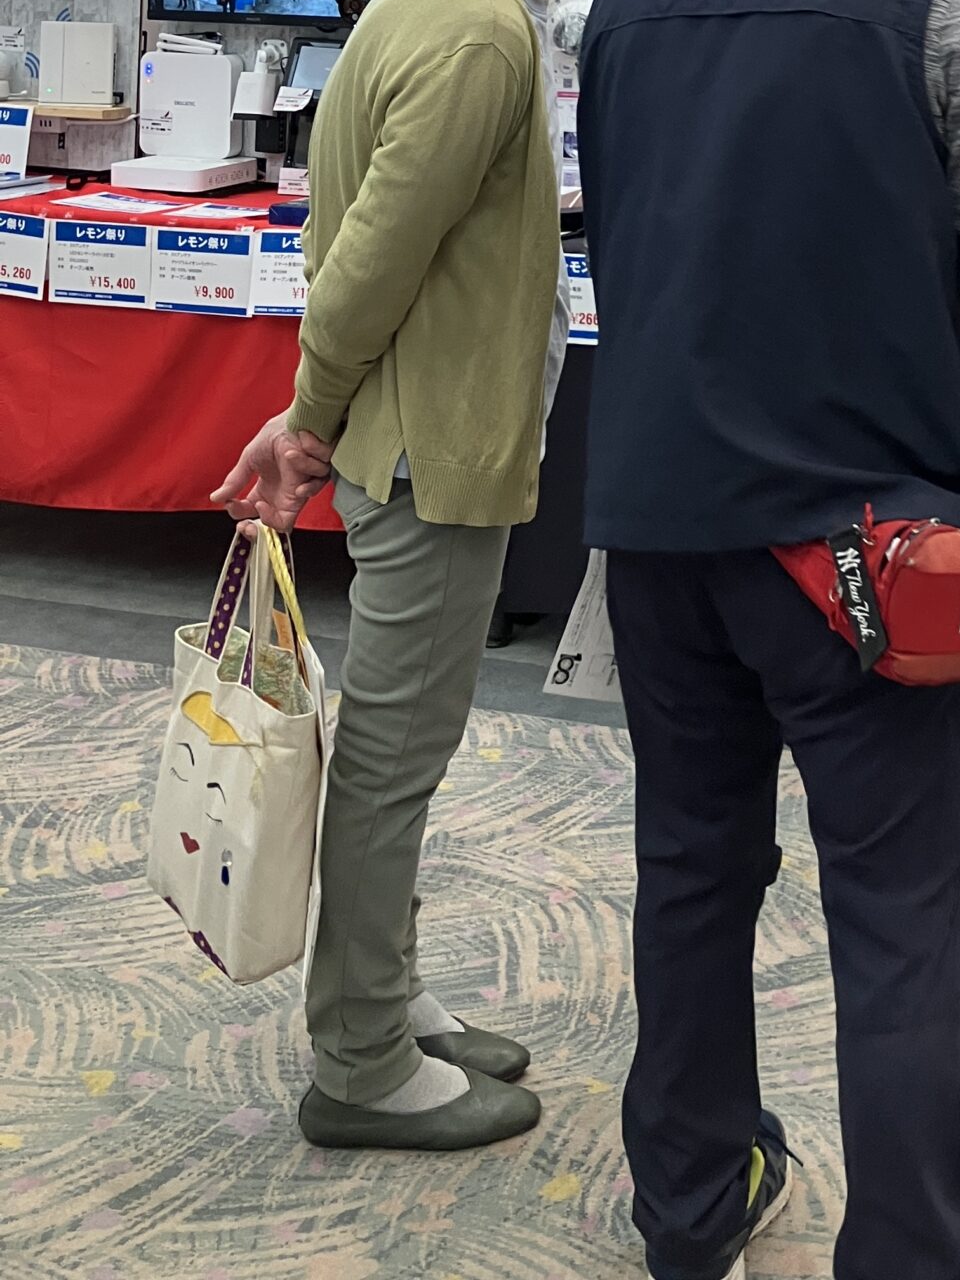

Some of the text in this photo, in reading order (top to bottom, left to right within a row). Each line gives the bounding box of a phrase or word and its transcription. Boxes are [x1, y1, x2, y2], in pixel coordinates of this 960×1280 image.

[75, 226, 126, 241] レモン祭り
[177, 235, 229, 250] レモン祭り
[90, 275, 136, 290] ¥15,400
[194, 285, 234, 300] ¥9,900
